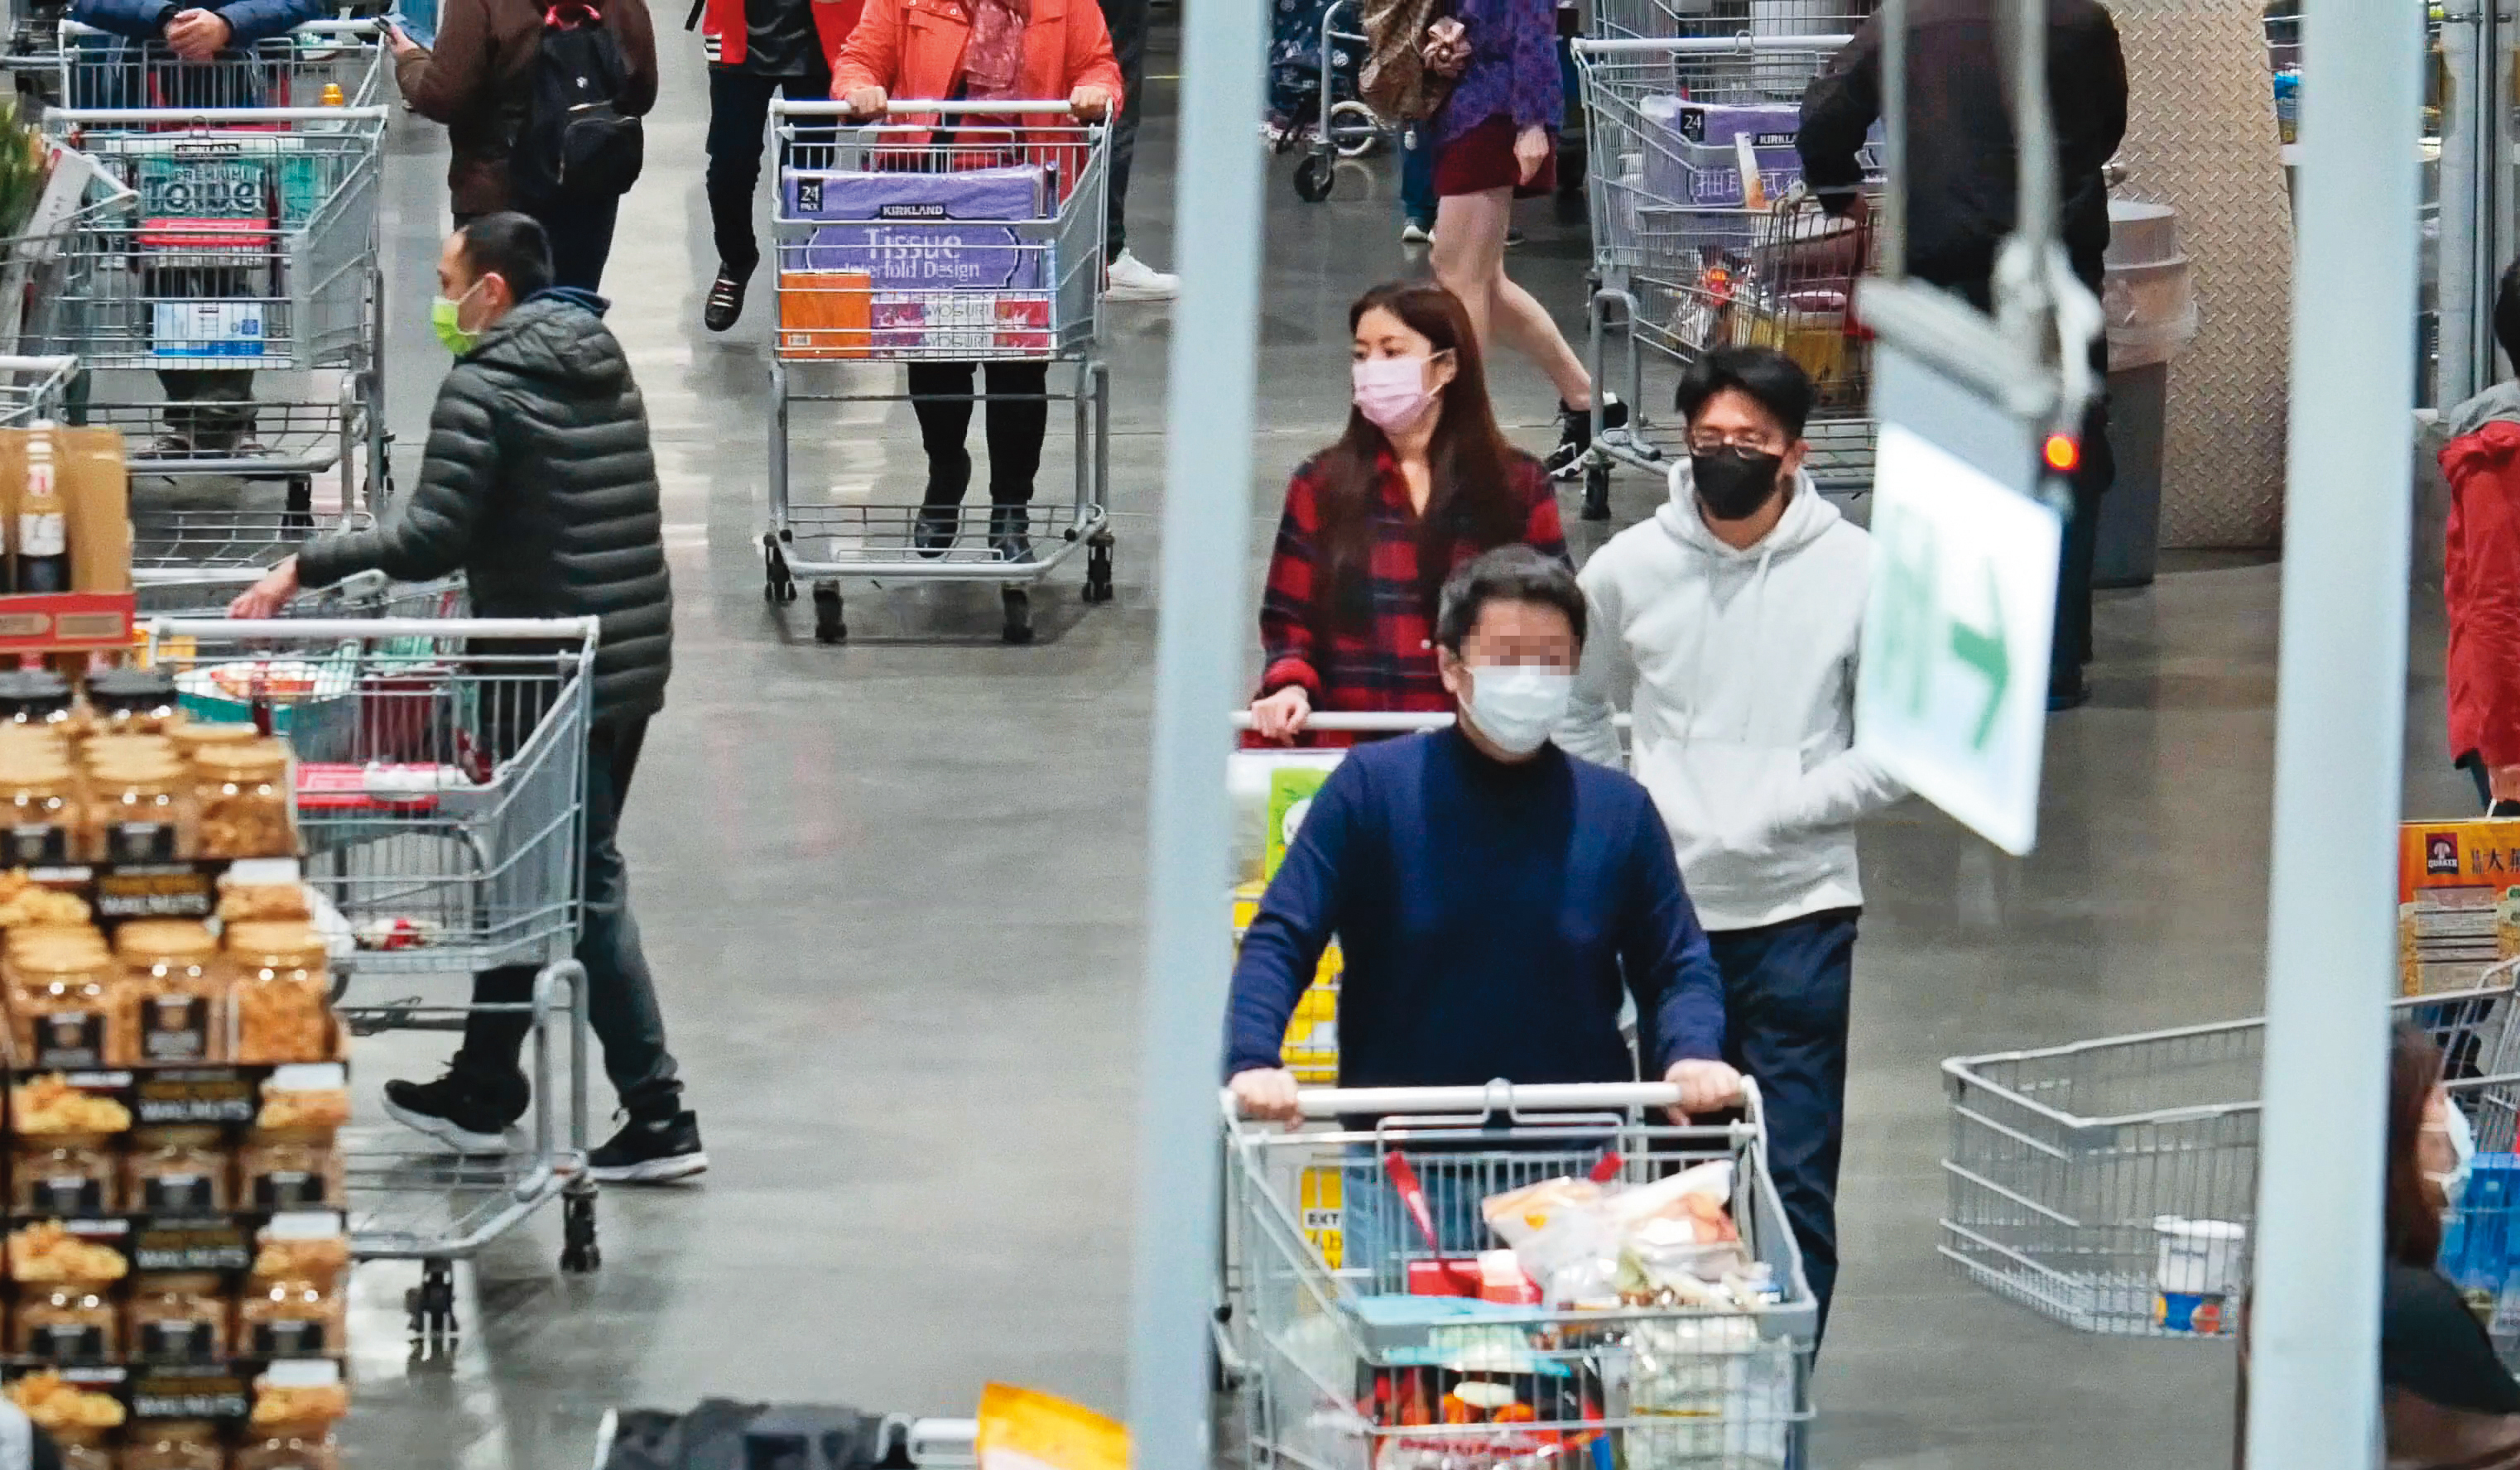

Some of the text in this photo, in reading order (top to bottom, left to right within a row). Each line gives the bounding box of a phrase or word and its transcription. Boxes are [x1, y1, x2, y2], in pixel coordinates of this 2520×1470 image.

[1683, 114, 1702, 130] 24
[144, 169, 266, 213] Towel
[800, 185, 820, 201] 24
[882, 204, 945, 216] KIRKLAND
[863, 226, 963, 259] Tissue
[924, 259, 980, 282] Design
[2427, 858, 2458, 869] QUAKER
